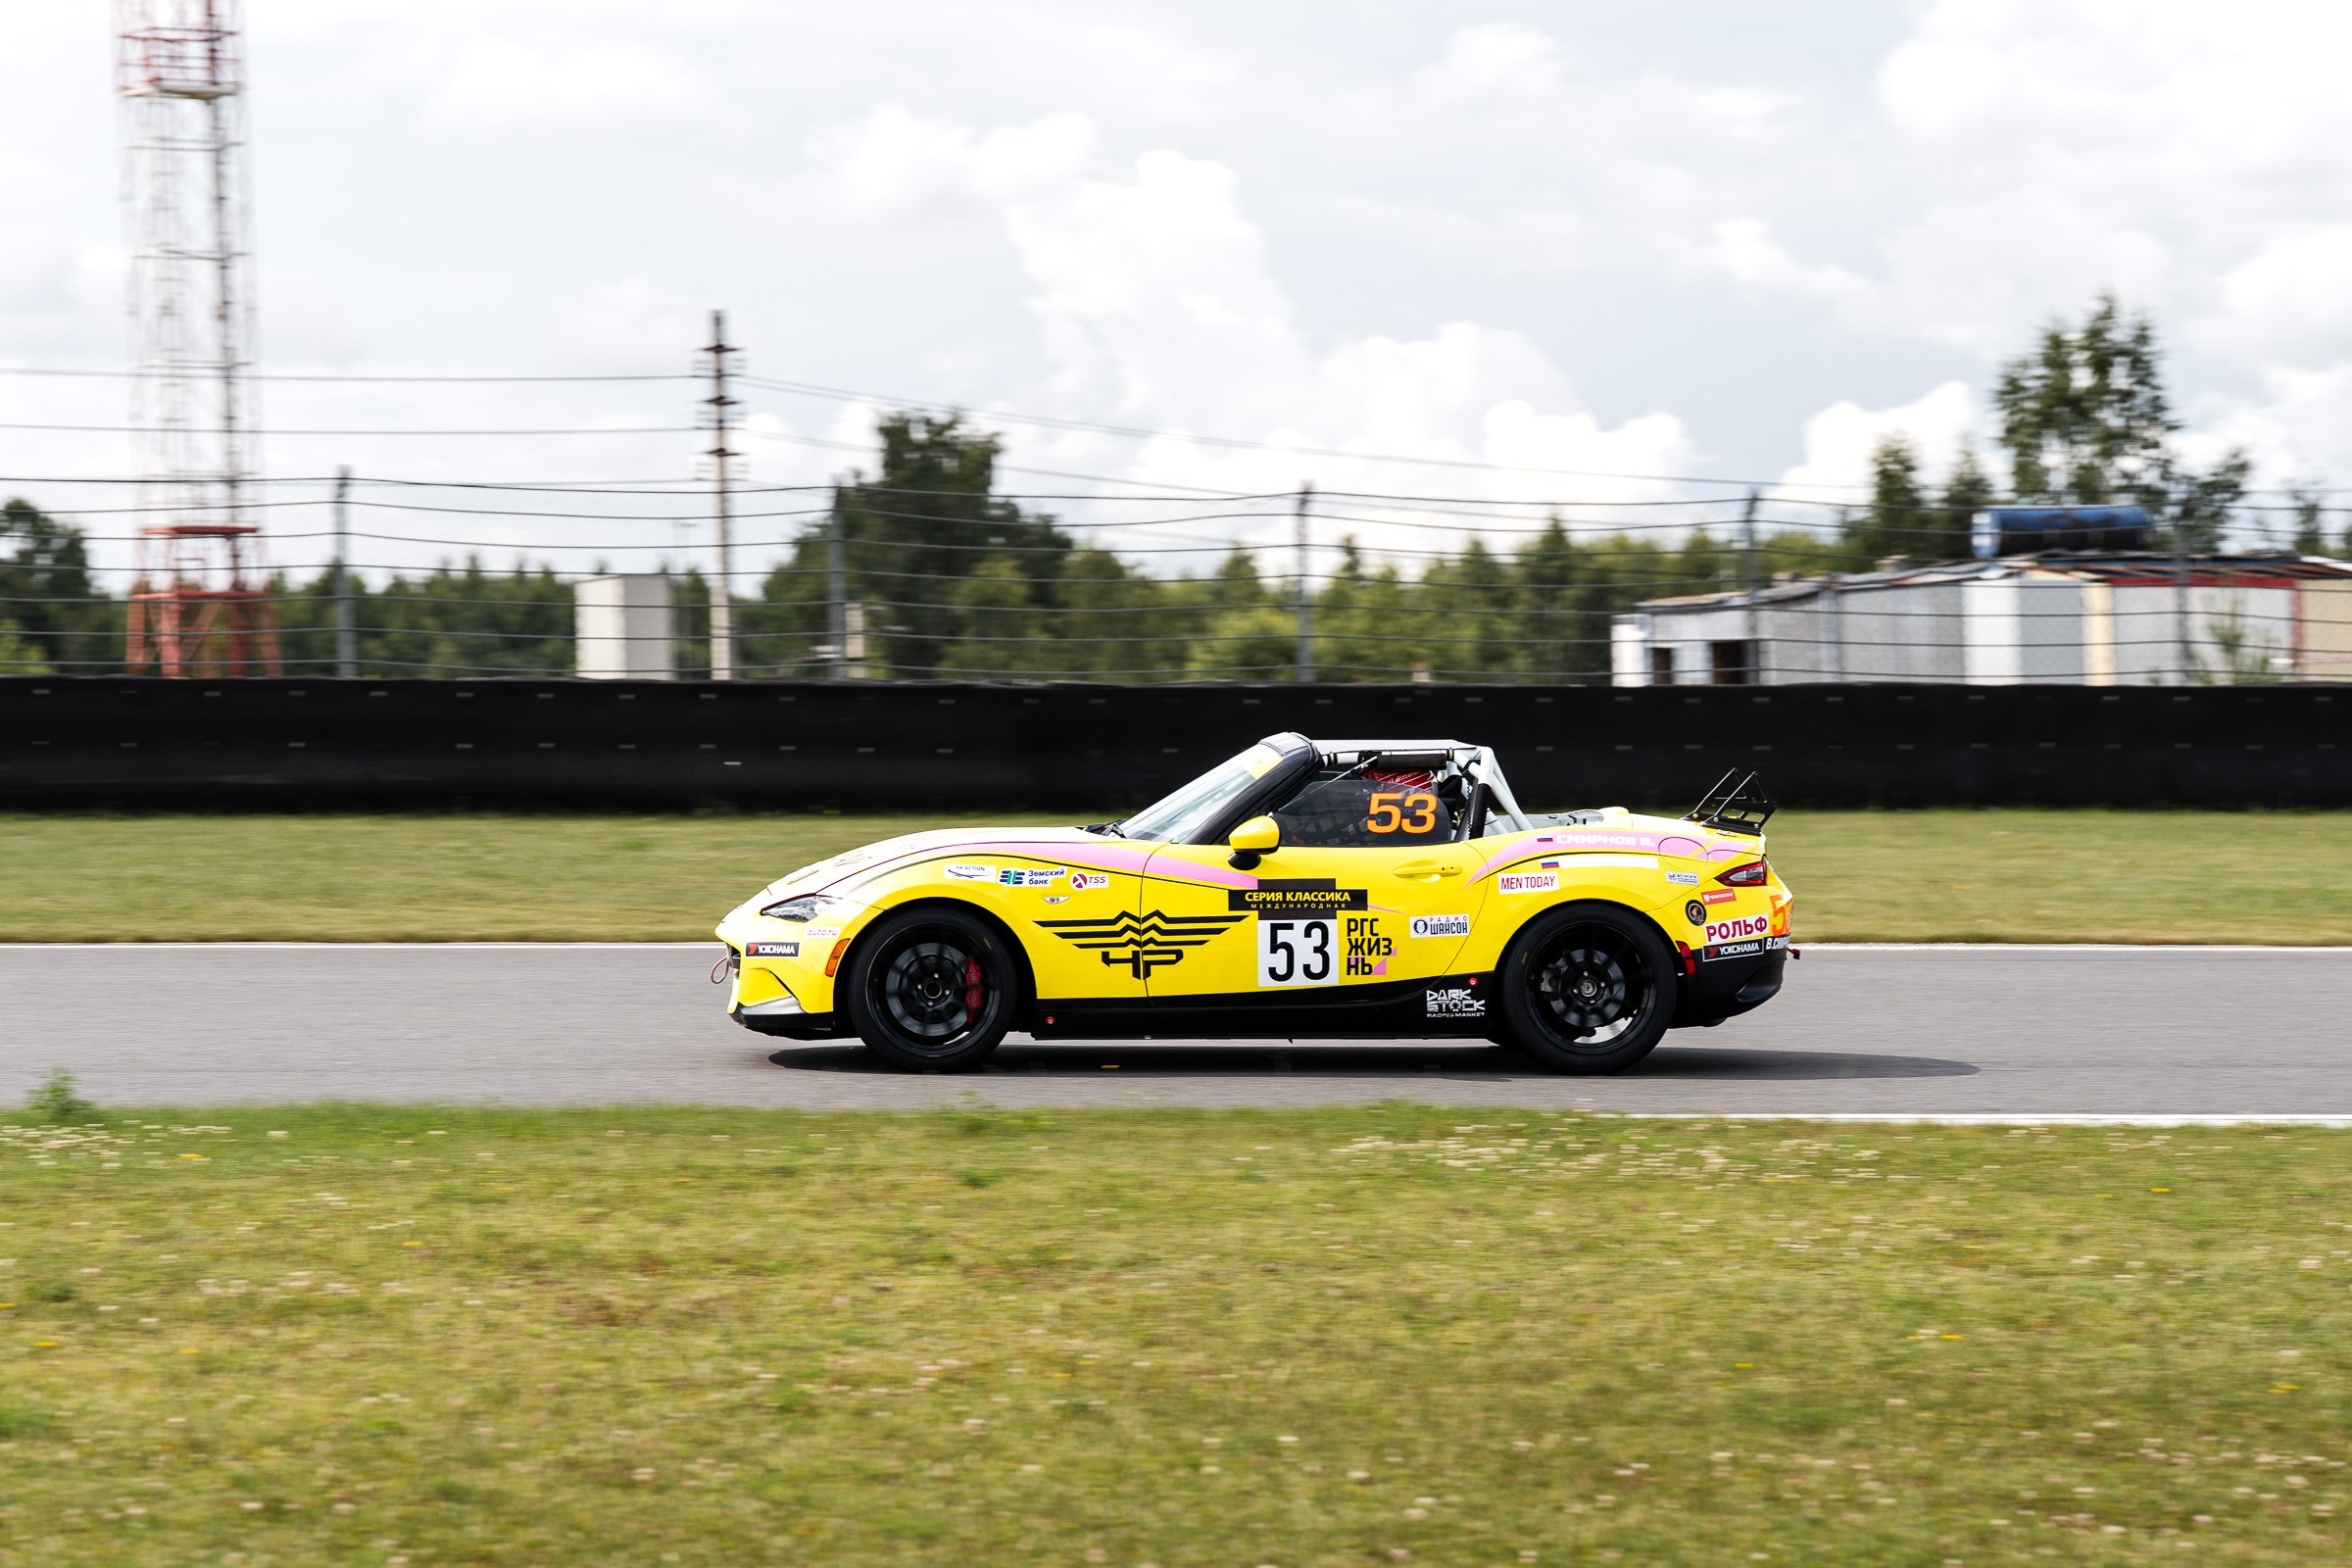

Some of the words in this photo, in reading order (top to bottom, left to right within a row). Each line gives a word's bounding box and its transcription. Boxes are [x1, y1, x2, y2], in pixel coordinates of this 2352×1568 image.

[1366, 792, 1438, 834] 53
[1555, 835, 1637, 846] СМИРНОВ
[1028, 868, 1065, 877] Земский
[1500, 877, 1523, 890] MEN
[1524, 875, 1555, 889] TODAY
[1245, 892, 1283, 902] СЕРИЯ
[1286, 892, 1350, 902] КЛАССИКА
[1347, 917, 1379, 937] РГС
[1430, 922, 1468, 935] ШАНСОН
[1705, 916, 1768, 942] РОЛЬФ
[758, 945, 795, 955] YOKOHAMA
[1268, 920, 1330, 982] 53
[1347, 938, 1393, 956] ЖИЗ
[1719, 942, 1760, 956] YOKOHAMA
[1347, 956, 1373, 975] НЬ
[1426, 989, 1471, 1001] DARK
[1427, 1000, 1486, 1011] STOCK
